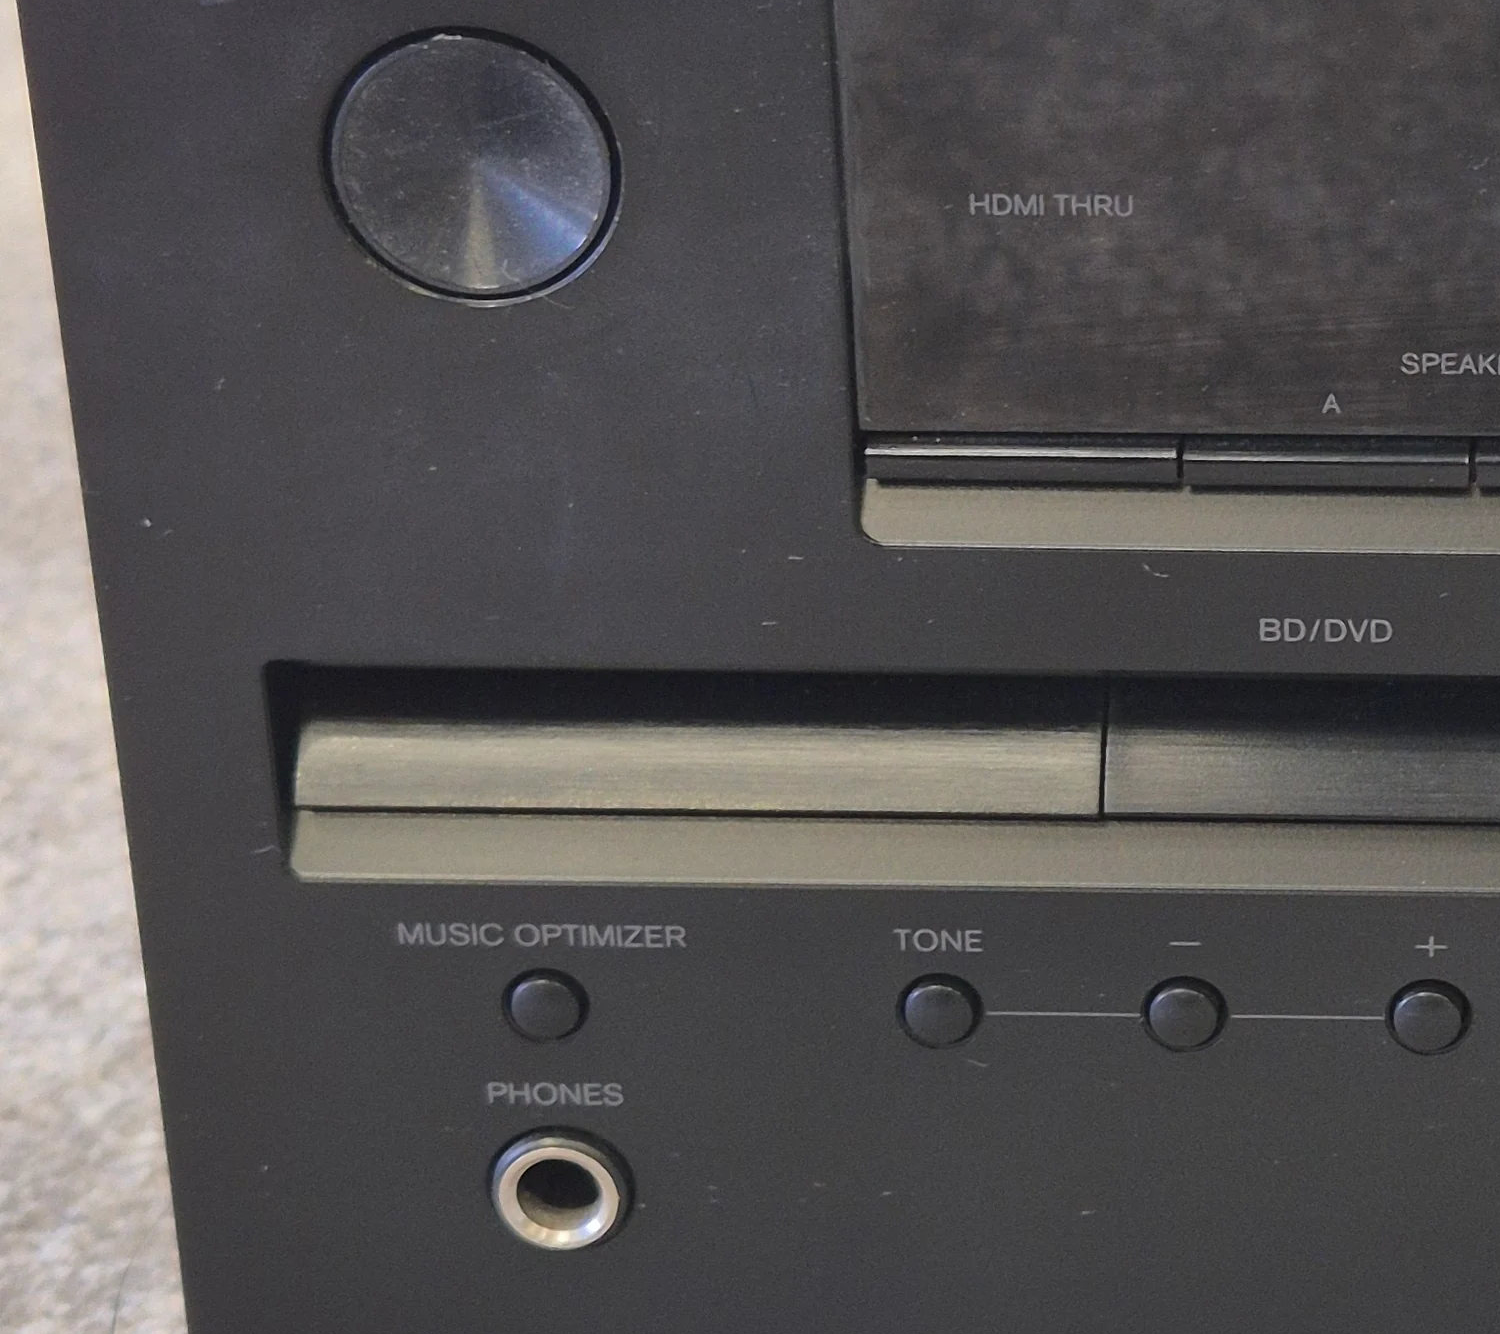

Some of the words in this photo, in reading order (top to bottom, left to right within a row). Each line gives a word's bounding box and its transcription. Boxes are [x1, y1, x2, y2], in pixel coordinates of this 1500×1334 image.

[968, 193, 1046, 217] HDMI
[1053, 194, 1134, 218] THRU
[1322, 393, 1342, 415] A
[1258, 618, 1393, 645] BD/DVD
[397, 922, 505, 948] MUSIC
[513, 924, 688, 950] OPTIMIZER
[892, 929, 984, 954] TONE
[486, 1081, 625, 1107] PHONES
